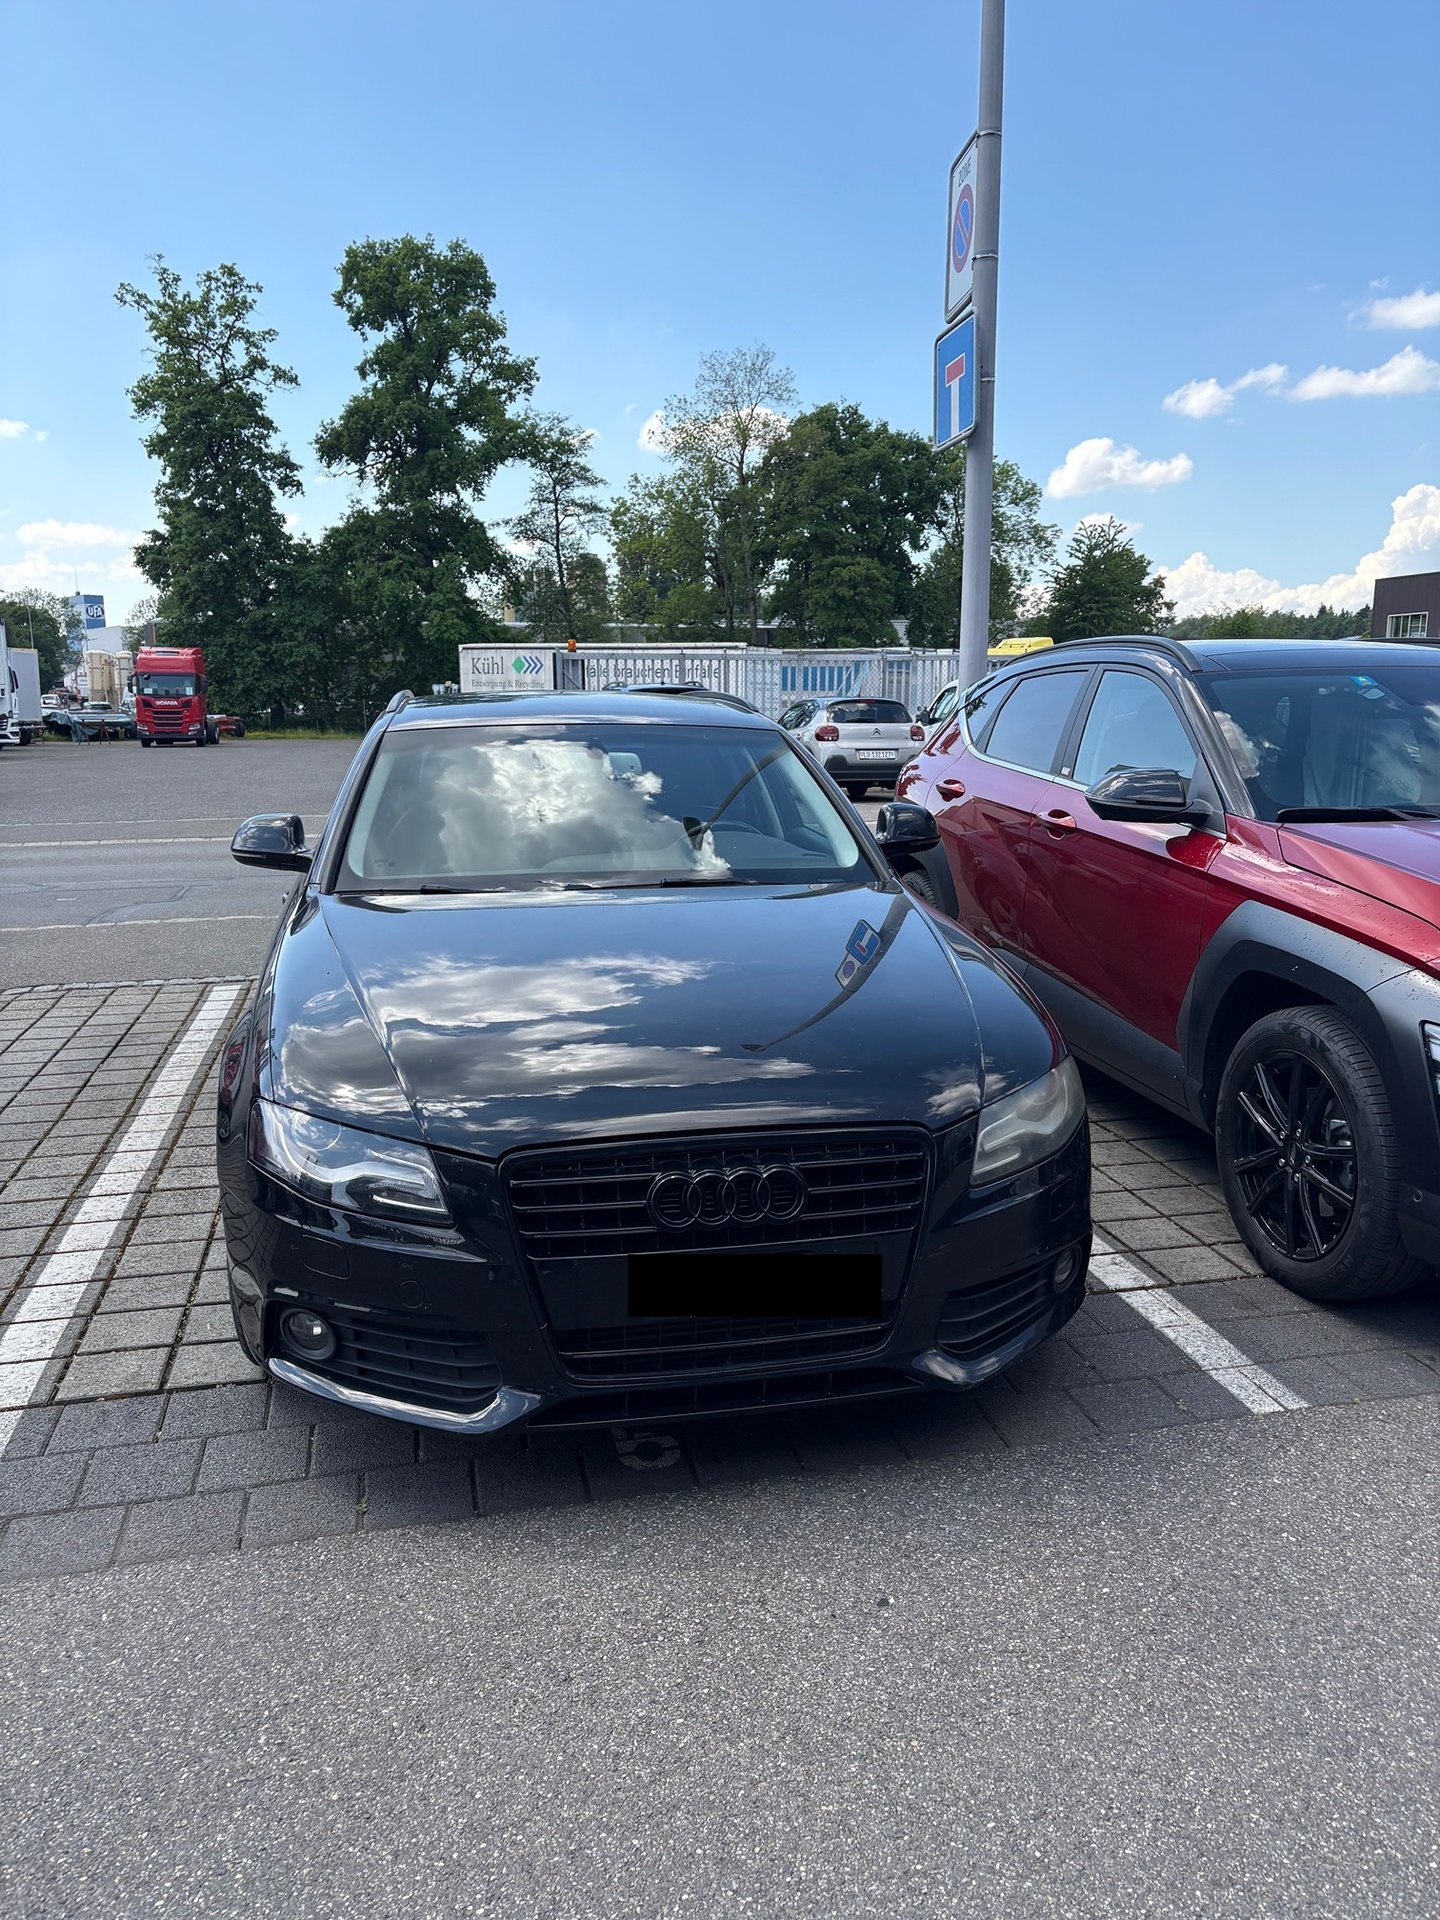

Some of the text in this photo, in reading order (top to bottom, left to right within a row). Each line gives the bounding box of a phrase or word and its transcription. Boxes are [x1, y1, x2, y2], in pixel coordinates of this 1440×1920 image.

[958, 156, 972, 187] ZONE
[87, 605, 103, 618] UFA
[471, 656, 504, 675] Kühl
[471, 680, 506, 689] Entsorgung
[515, 680, 545, 689] Recycling
